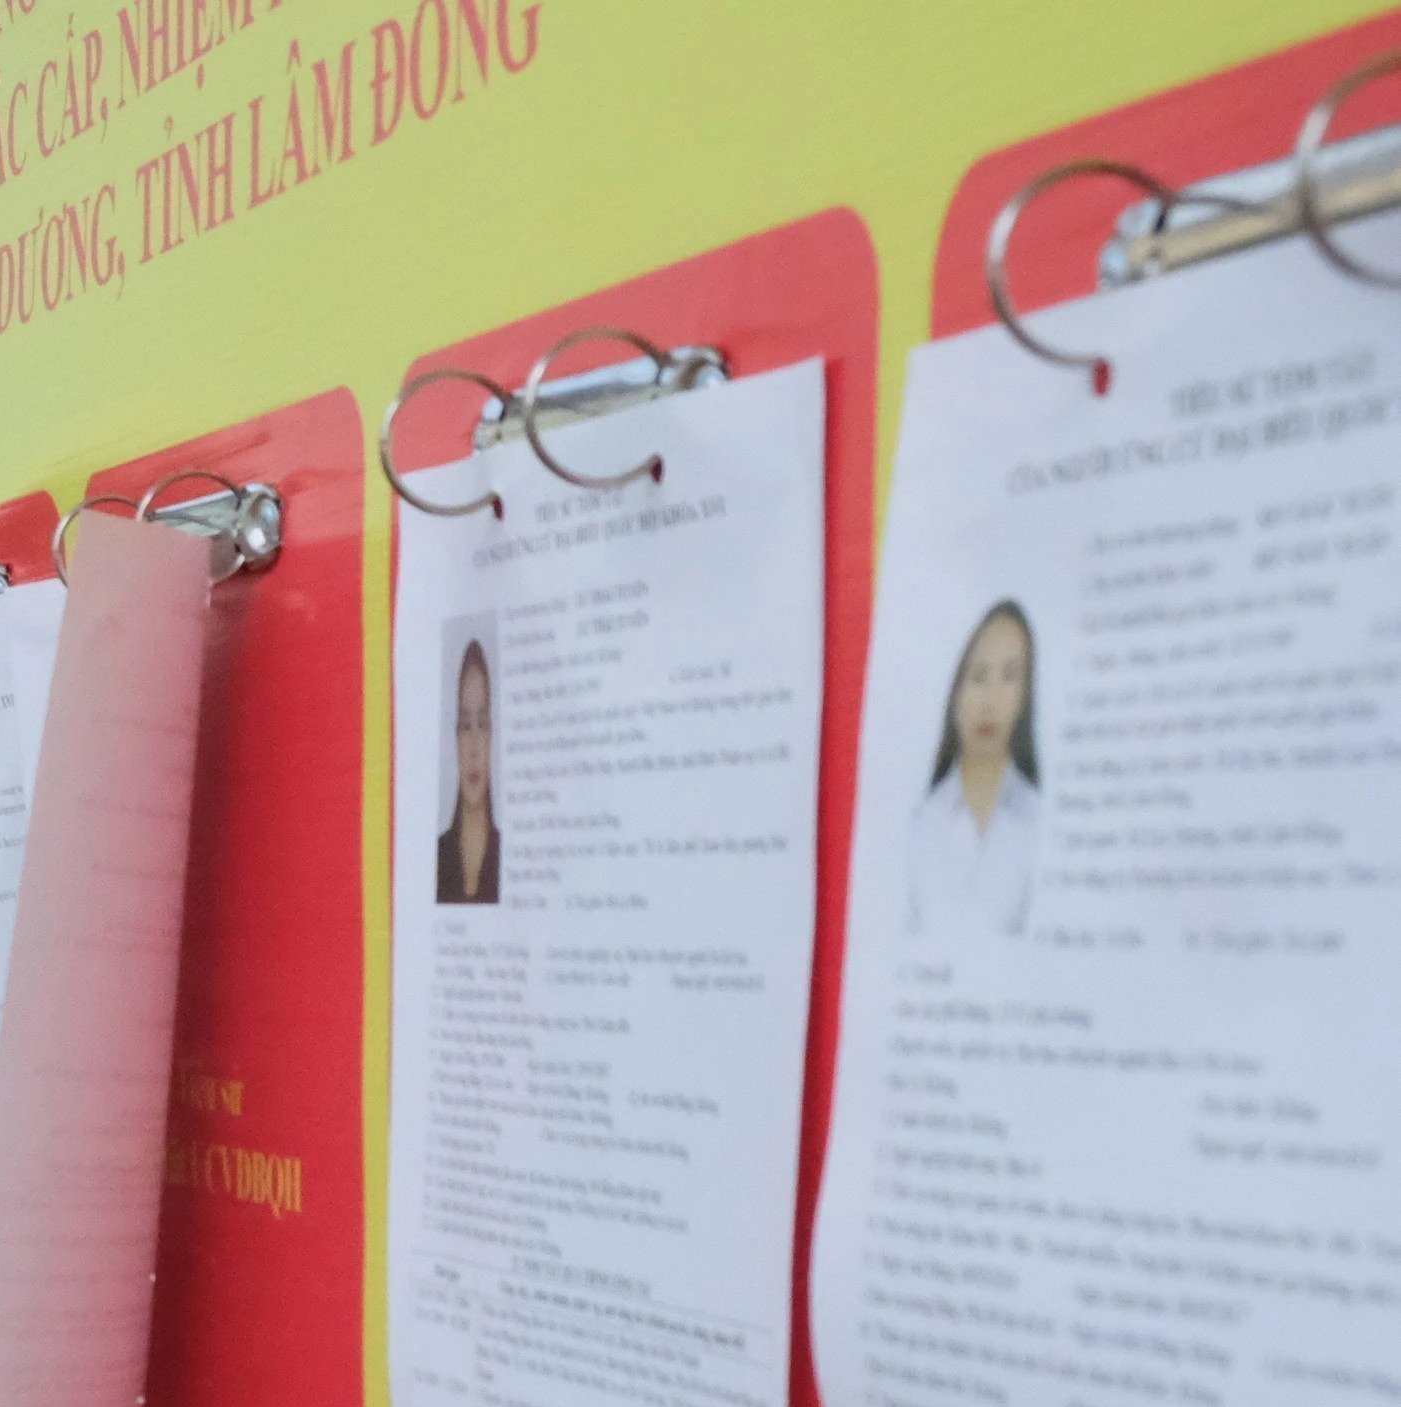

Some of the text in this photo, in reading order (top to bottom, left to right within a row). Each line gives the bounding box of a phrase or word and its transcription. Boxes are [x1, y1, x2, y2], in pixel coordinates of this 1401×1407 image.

[36, 11, 109, 158] CẤP,
[135, 114, 238, 266] TỈNH
[247, 37, 358, 211] LÂM
